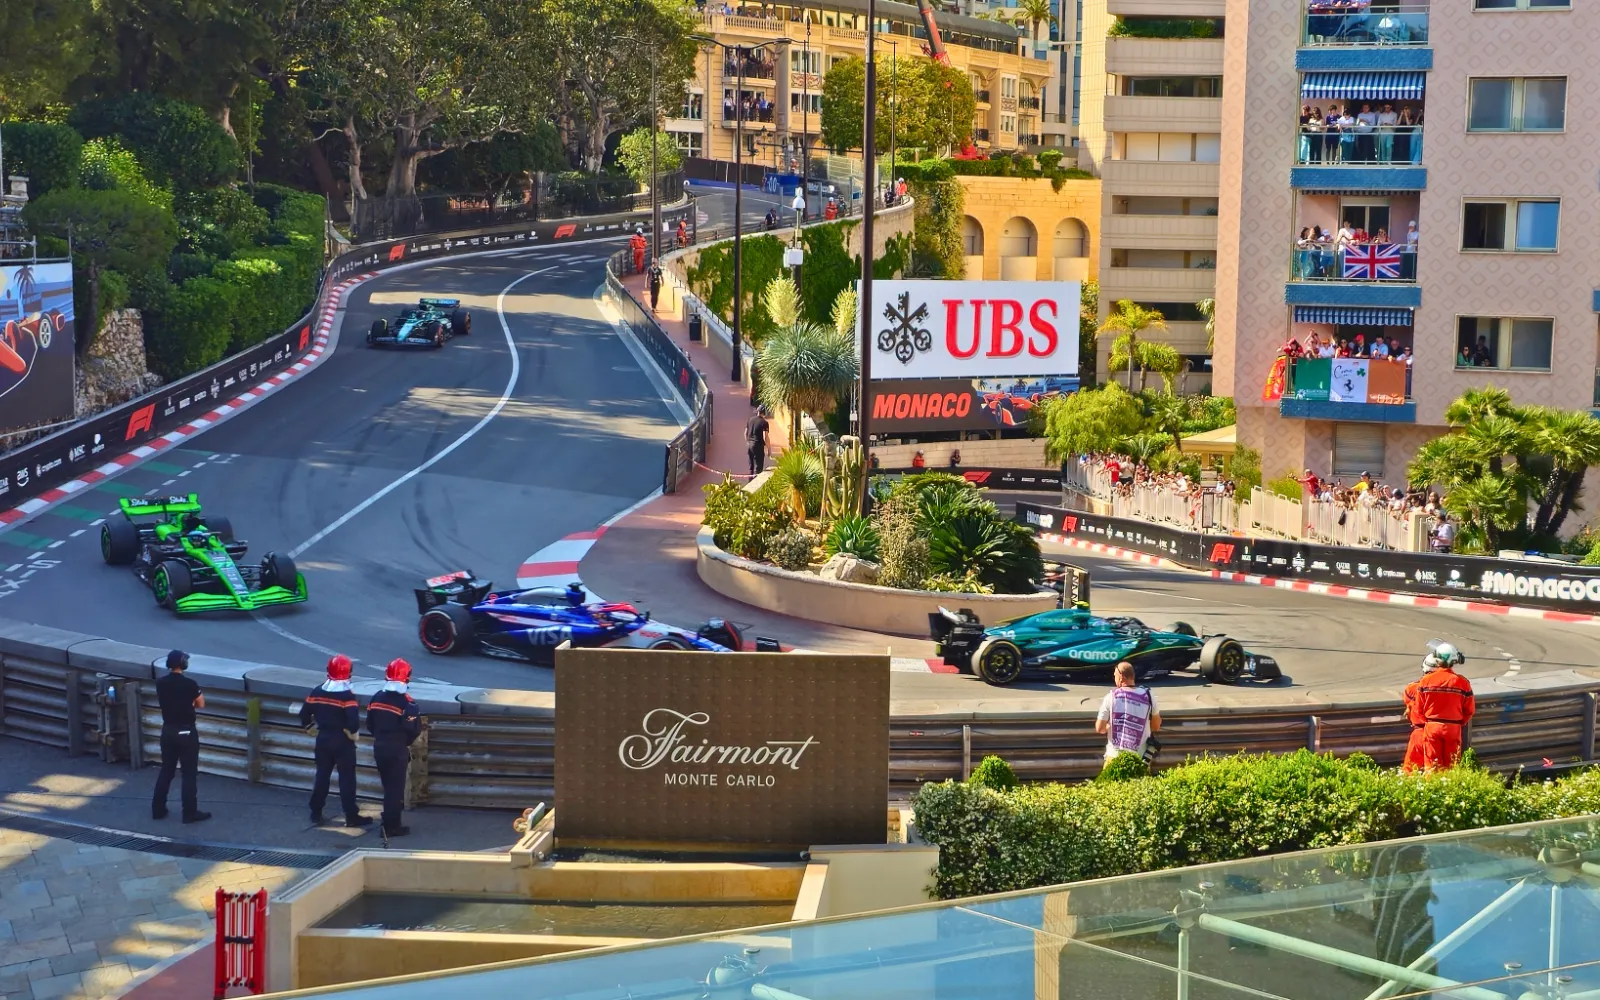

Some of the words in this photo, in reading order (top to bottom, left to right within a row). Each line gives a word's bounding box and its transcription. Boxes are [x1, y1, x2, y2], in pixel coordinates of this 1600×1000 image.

[942, 299, 1058, 359] UBS
[873, 392, 971, 419] MONACO
[527, 626, 575, 646] VISA
[1069, 649, 1118, 661] aramco
[618, 708, 821, 770] Fairmont
[664, 773, 718, 786] MONTE
[726, 774, 776, 787] CARLO
